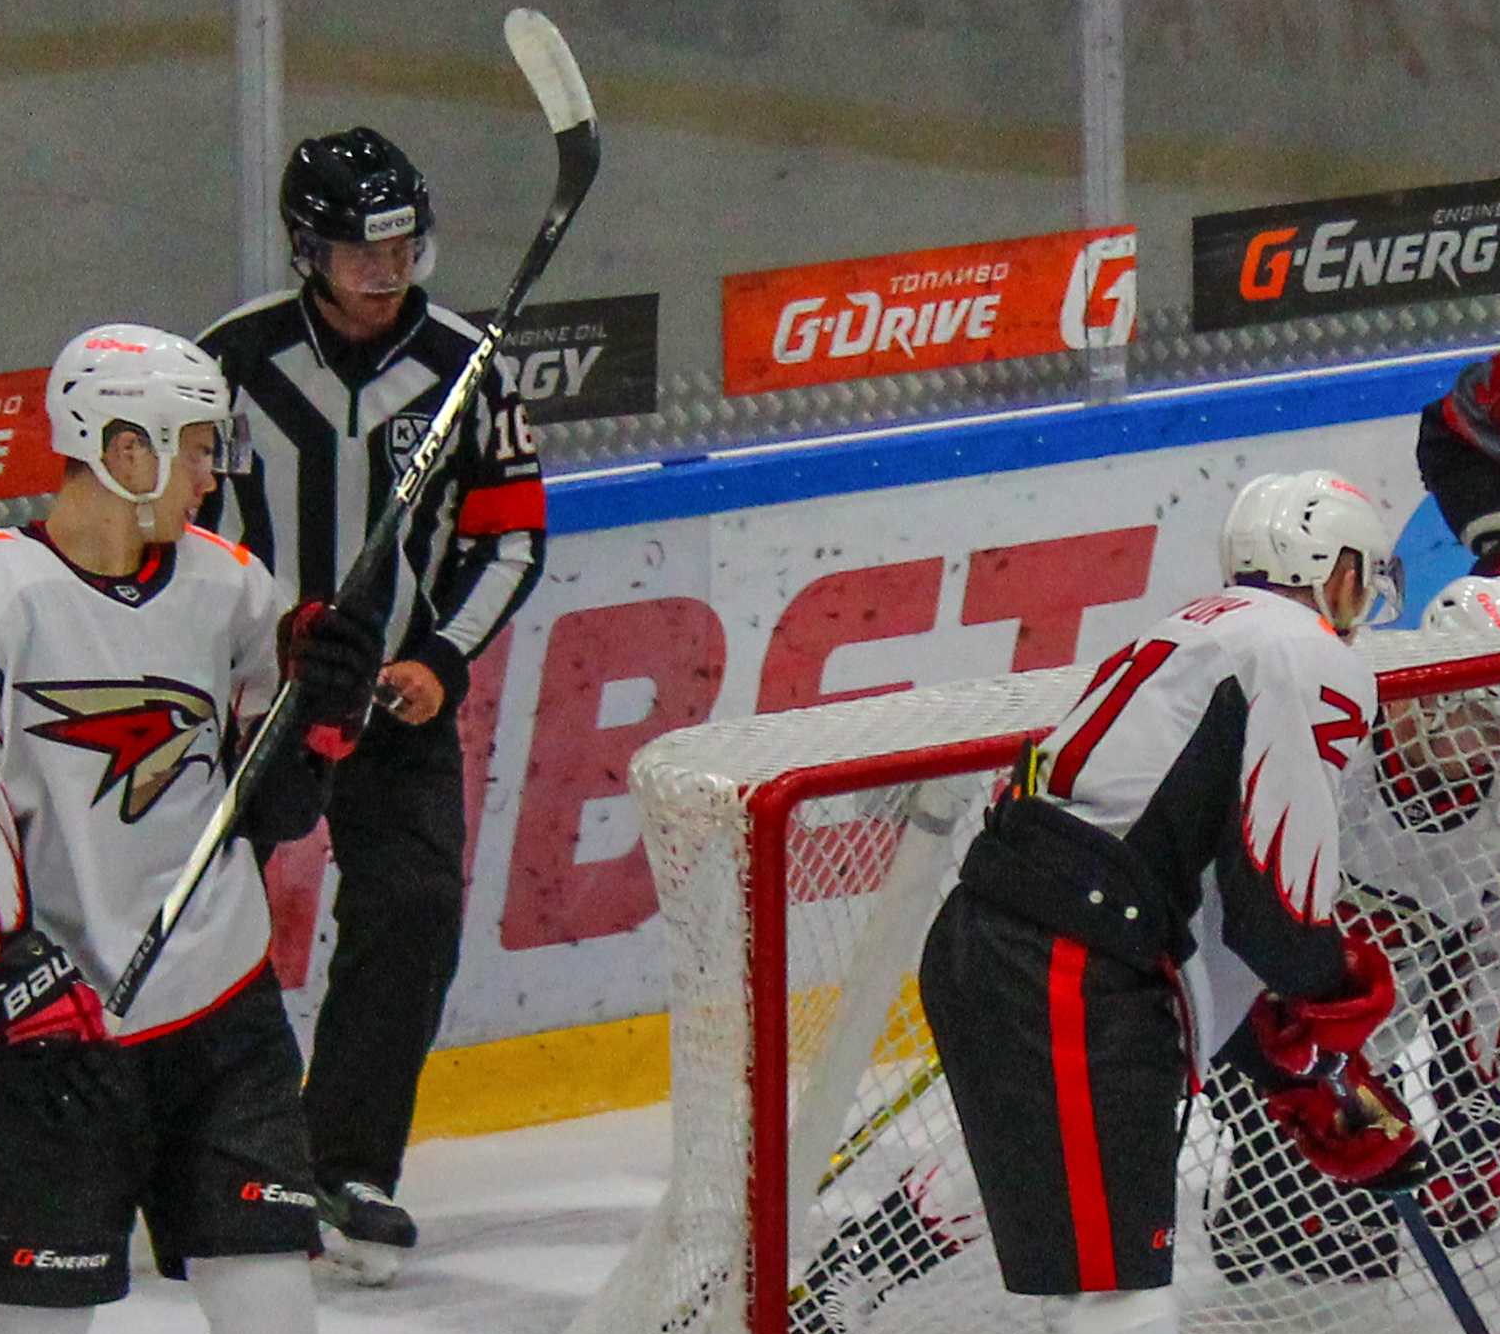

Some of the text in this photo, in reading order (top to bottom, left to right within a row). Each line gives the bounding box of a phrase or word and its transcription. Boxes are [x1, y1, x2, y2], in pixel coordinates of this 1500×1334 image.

[889, 262, 1010, 295] ТОПЛИВО
[503, 326, 571, 346] NGINE
[772, 290, 1002, 365] G-DRIVE
